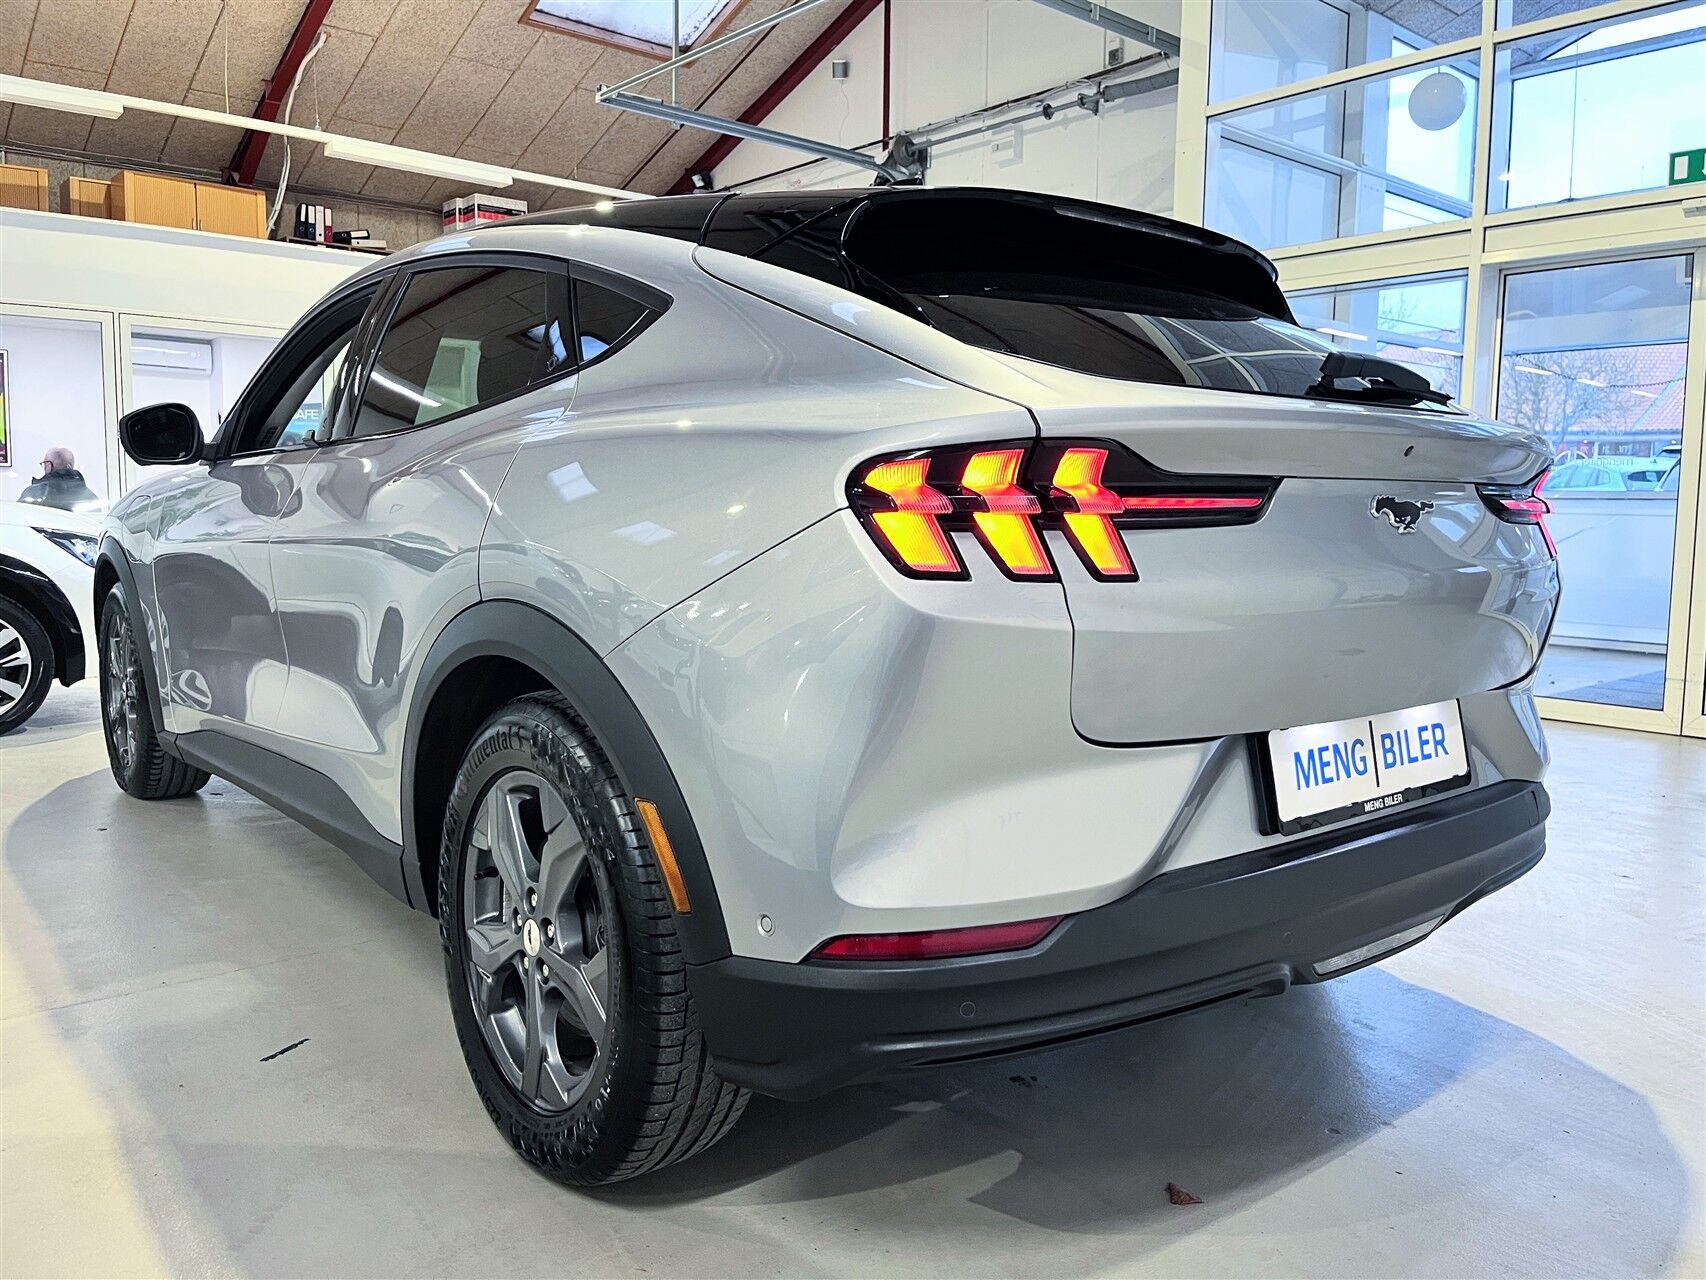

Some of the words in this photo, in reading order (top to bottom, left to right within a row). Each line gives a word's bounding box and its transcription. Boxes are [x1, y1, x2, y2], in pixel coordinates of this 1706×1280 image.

[296, 409, 319, 420] AFE
[1293, 738, 1368, 790] MENG
[1380, 722, 1449, 770] BILER
[1364, 798, 1384, 812] MENG
[1384, 793, 1403, 807] BILER
